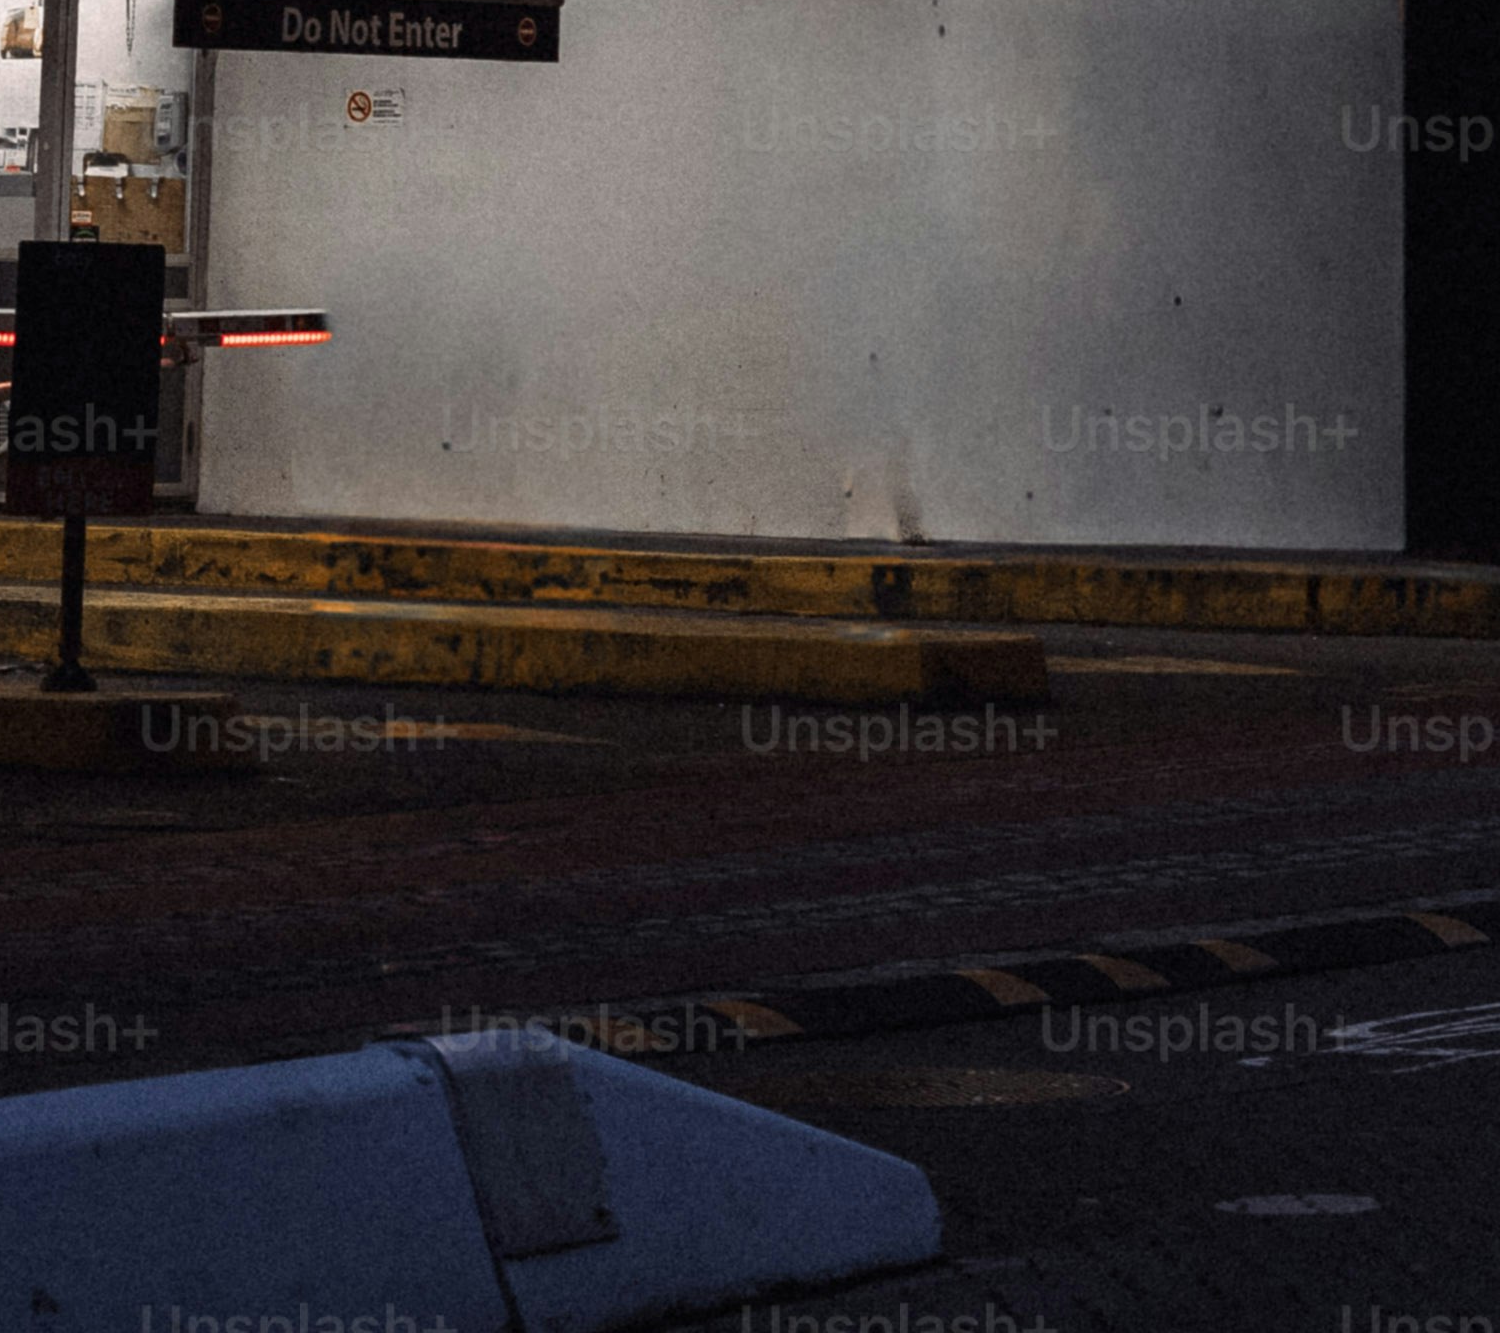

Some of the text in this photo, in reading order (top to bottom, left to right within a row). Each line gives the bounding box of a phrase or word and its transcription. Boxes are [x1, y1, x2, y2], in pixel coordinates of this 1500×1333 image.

[281, 5, 464, 50] Do Not Enter
